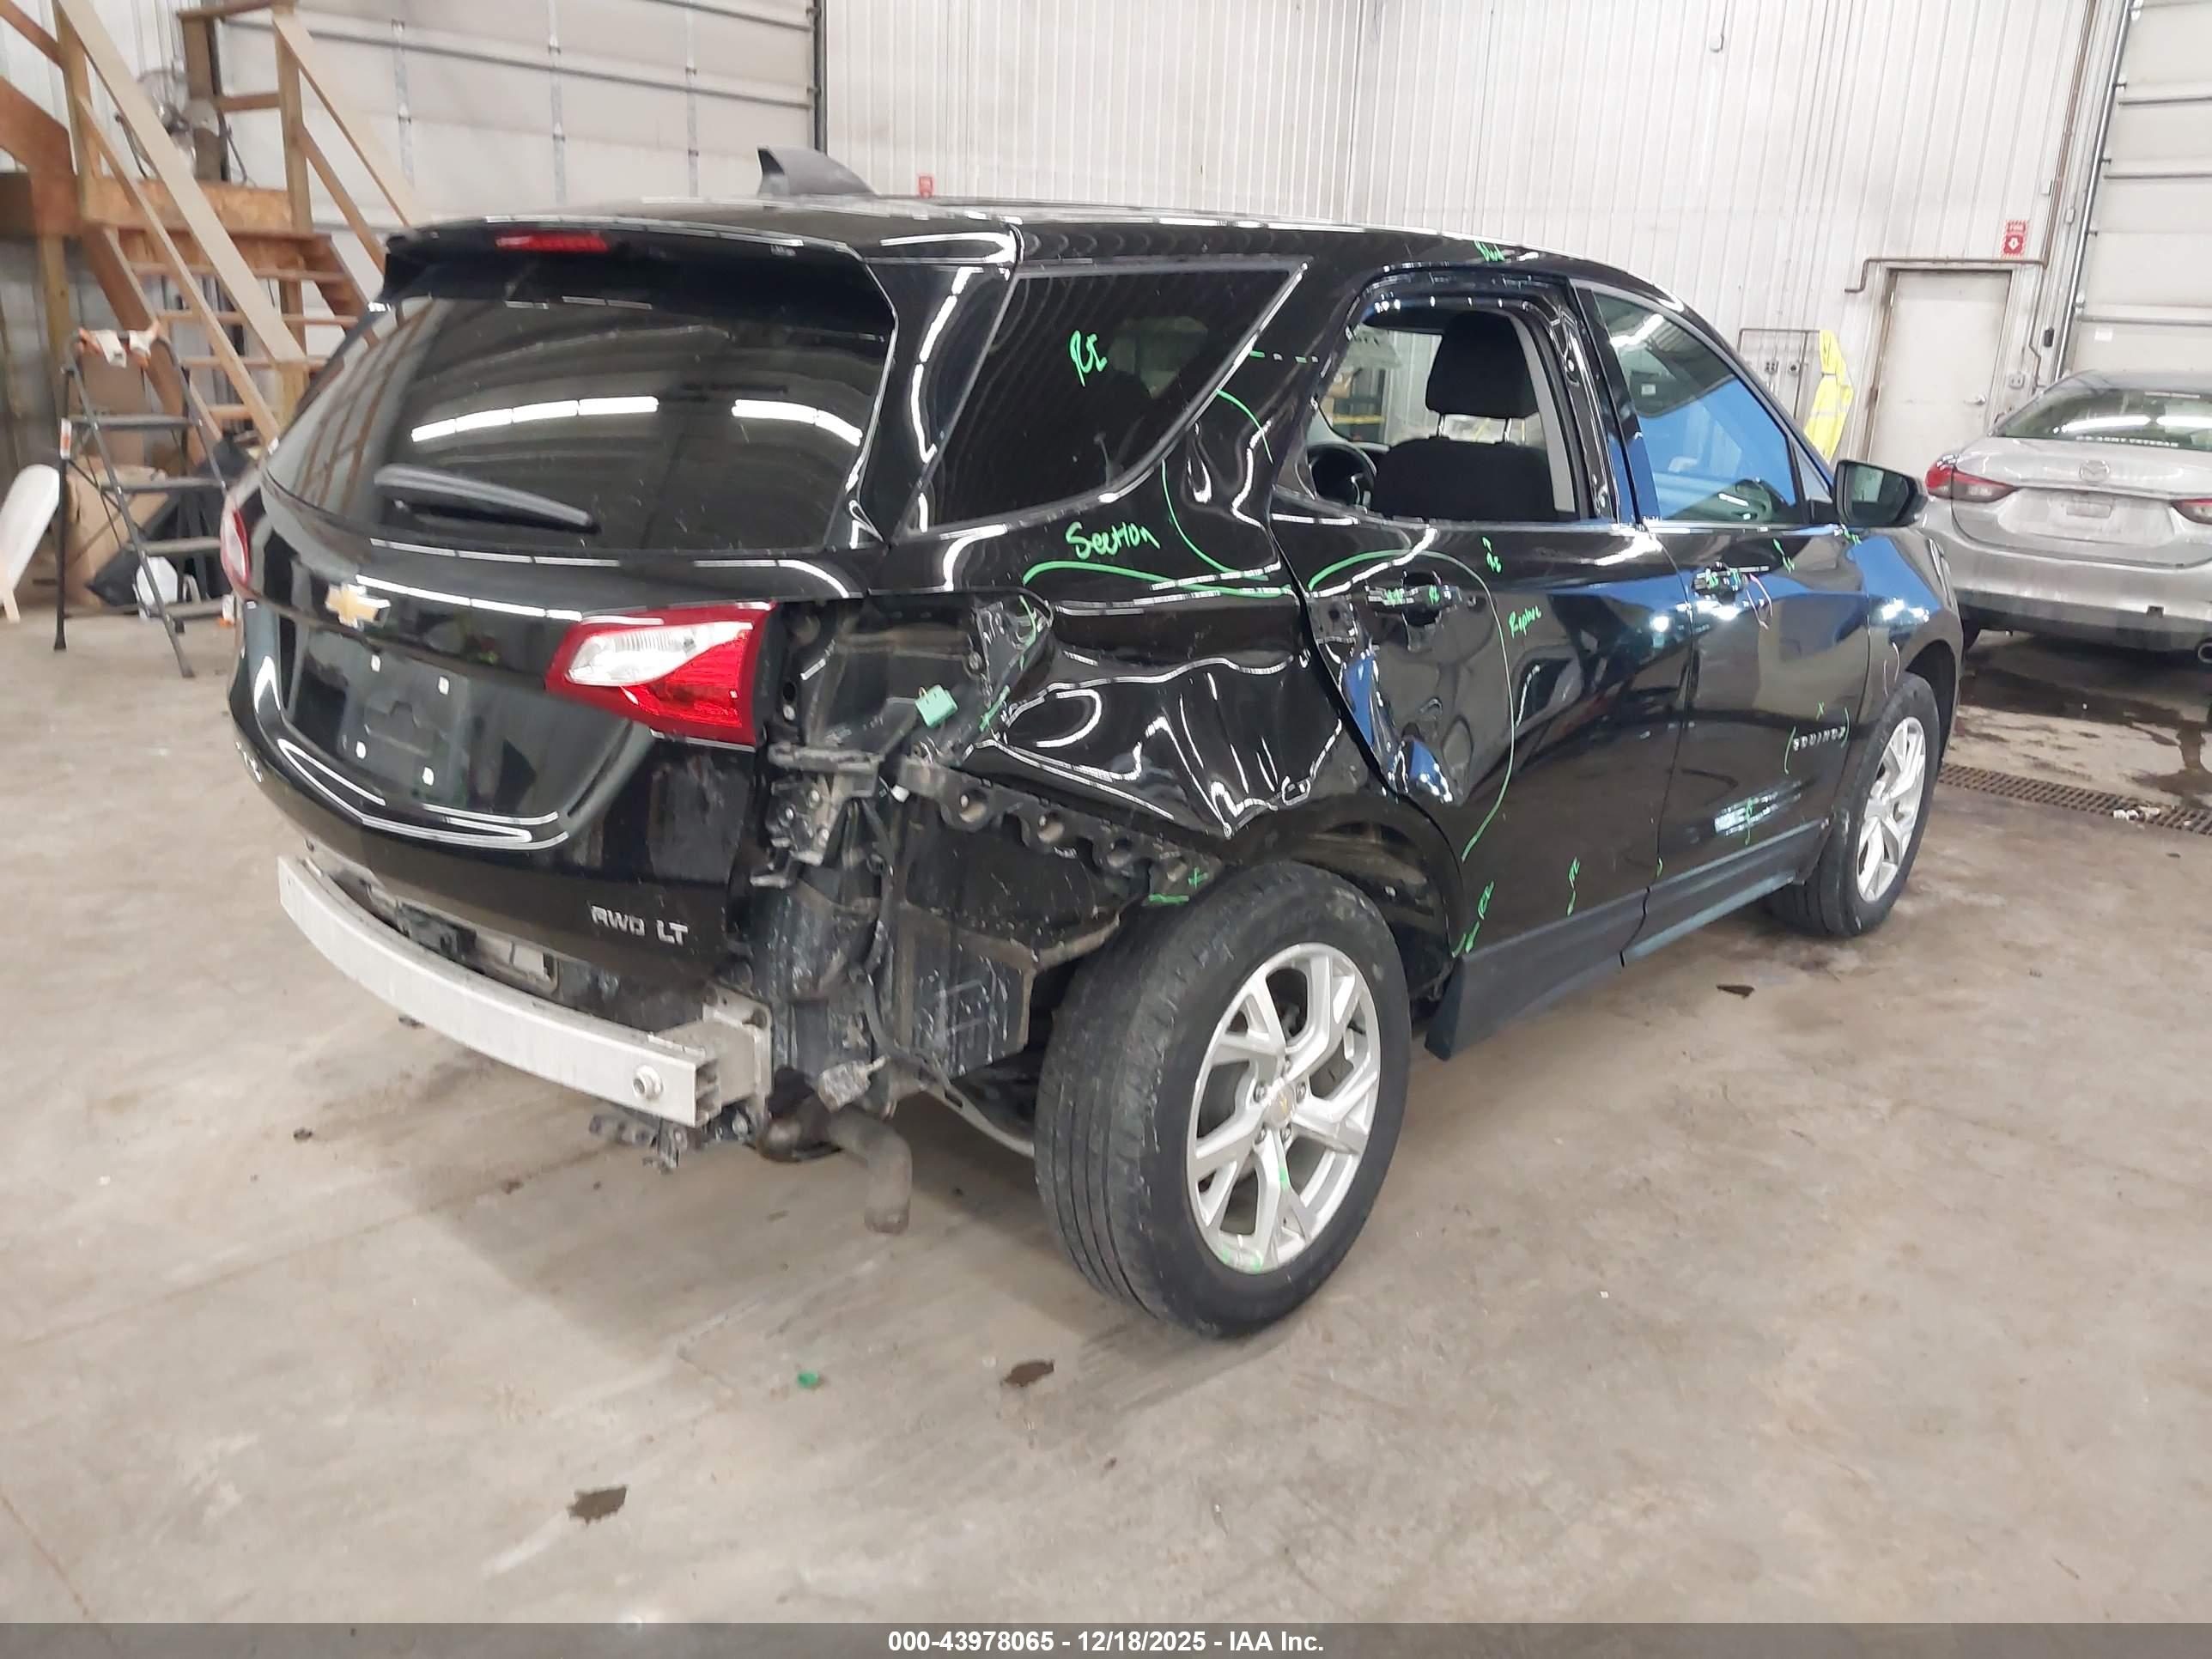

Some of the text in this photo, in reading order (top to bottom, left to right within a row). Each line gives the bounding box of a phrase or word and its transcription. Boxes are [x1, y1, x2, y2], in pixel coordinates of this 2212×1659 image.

[1066, 521, 1161, 560] Section
[1793, 726, 1846, 752] EQUINOX
[591, 905, 689, 945] AWD LT
